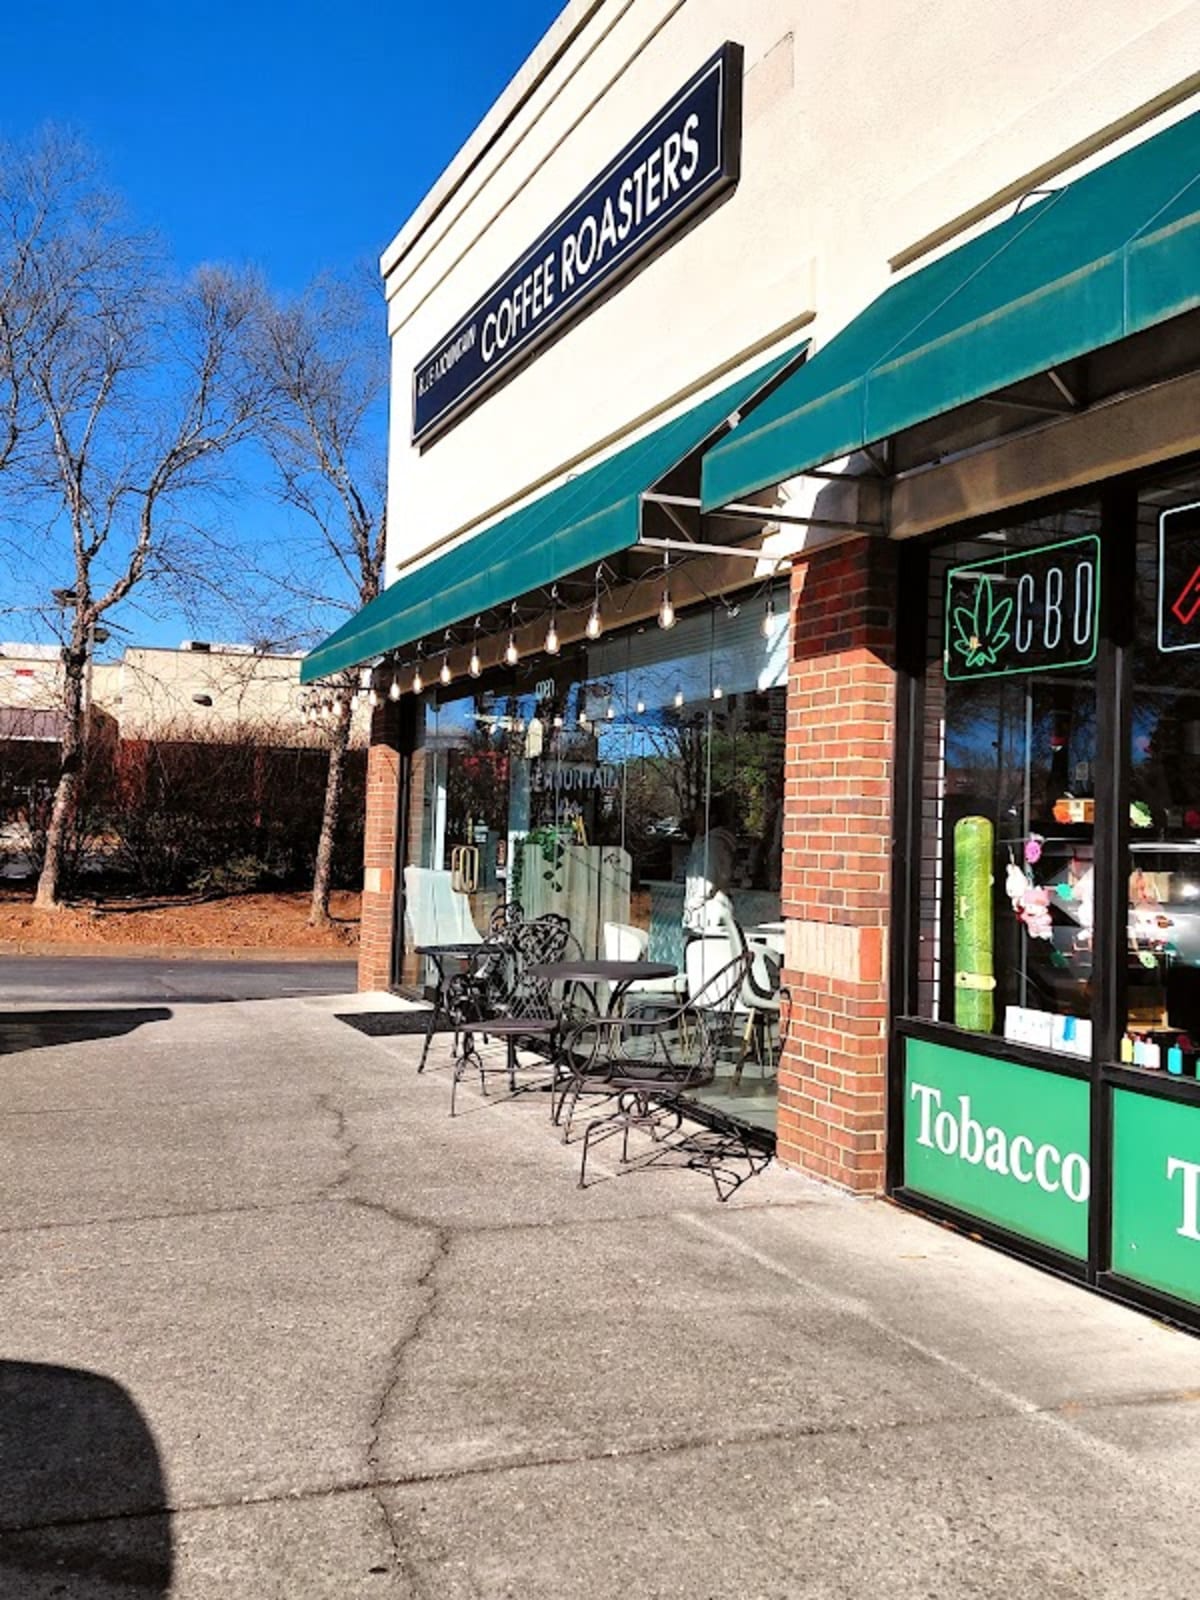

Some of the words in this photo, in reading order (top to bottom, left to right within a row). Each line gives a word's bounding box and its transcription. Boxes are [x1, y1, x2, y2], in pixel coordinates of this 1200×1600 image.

[481, 253, 554, 363] COFFEE
[561, 113, 699, 293] ROASTERS
[1015, 561, 1093, 653] CBD
[911, 1081, 1091, 1203] Tobacco
